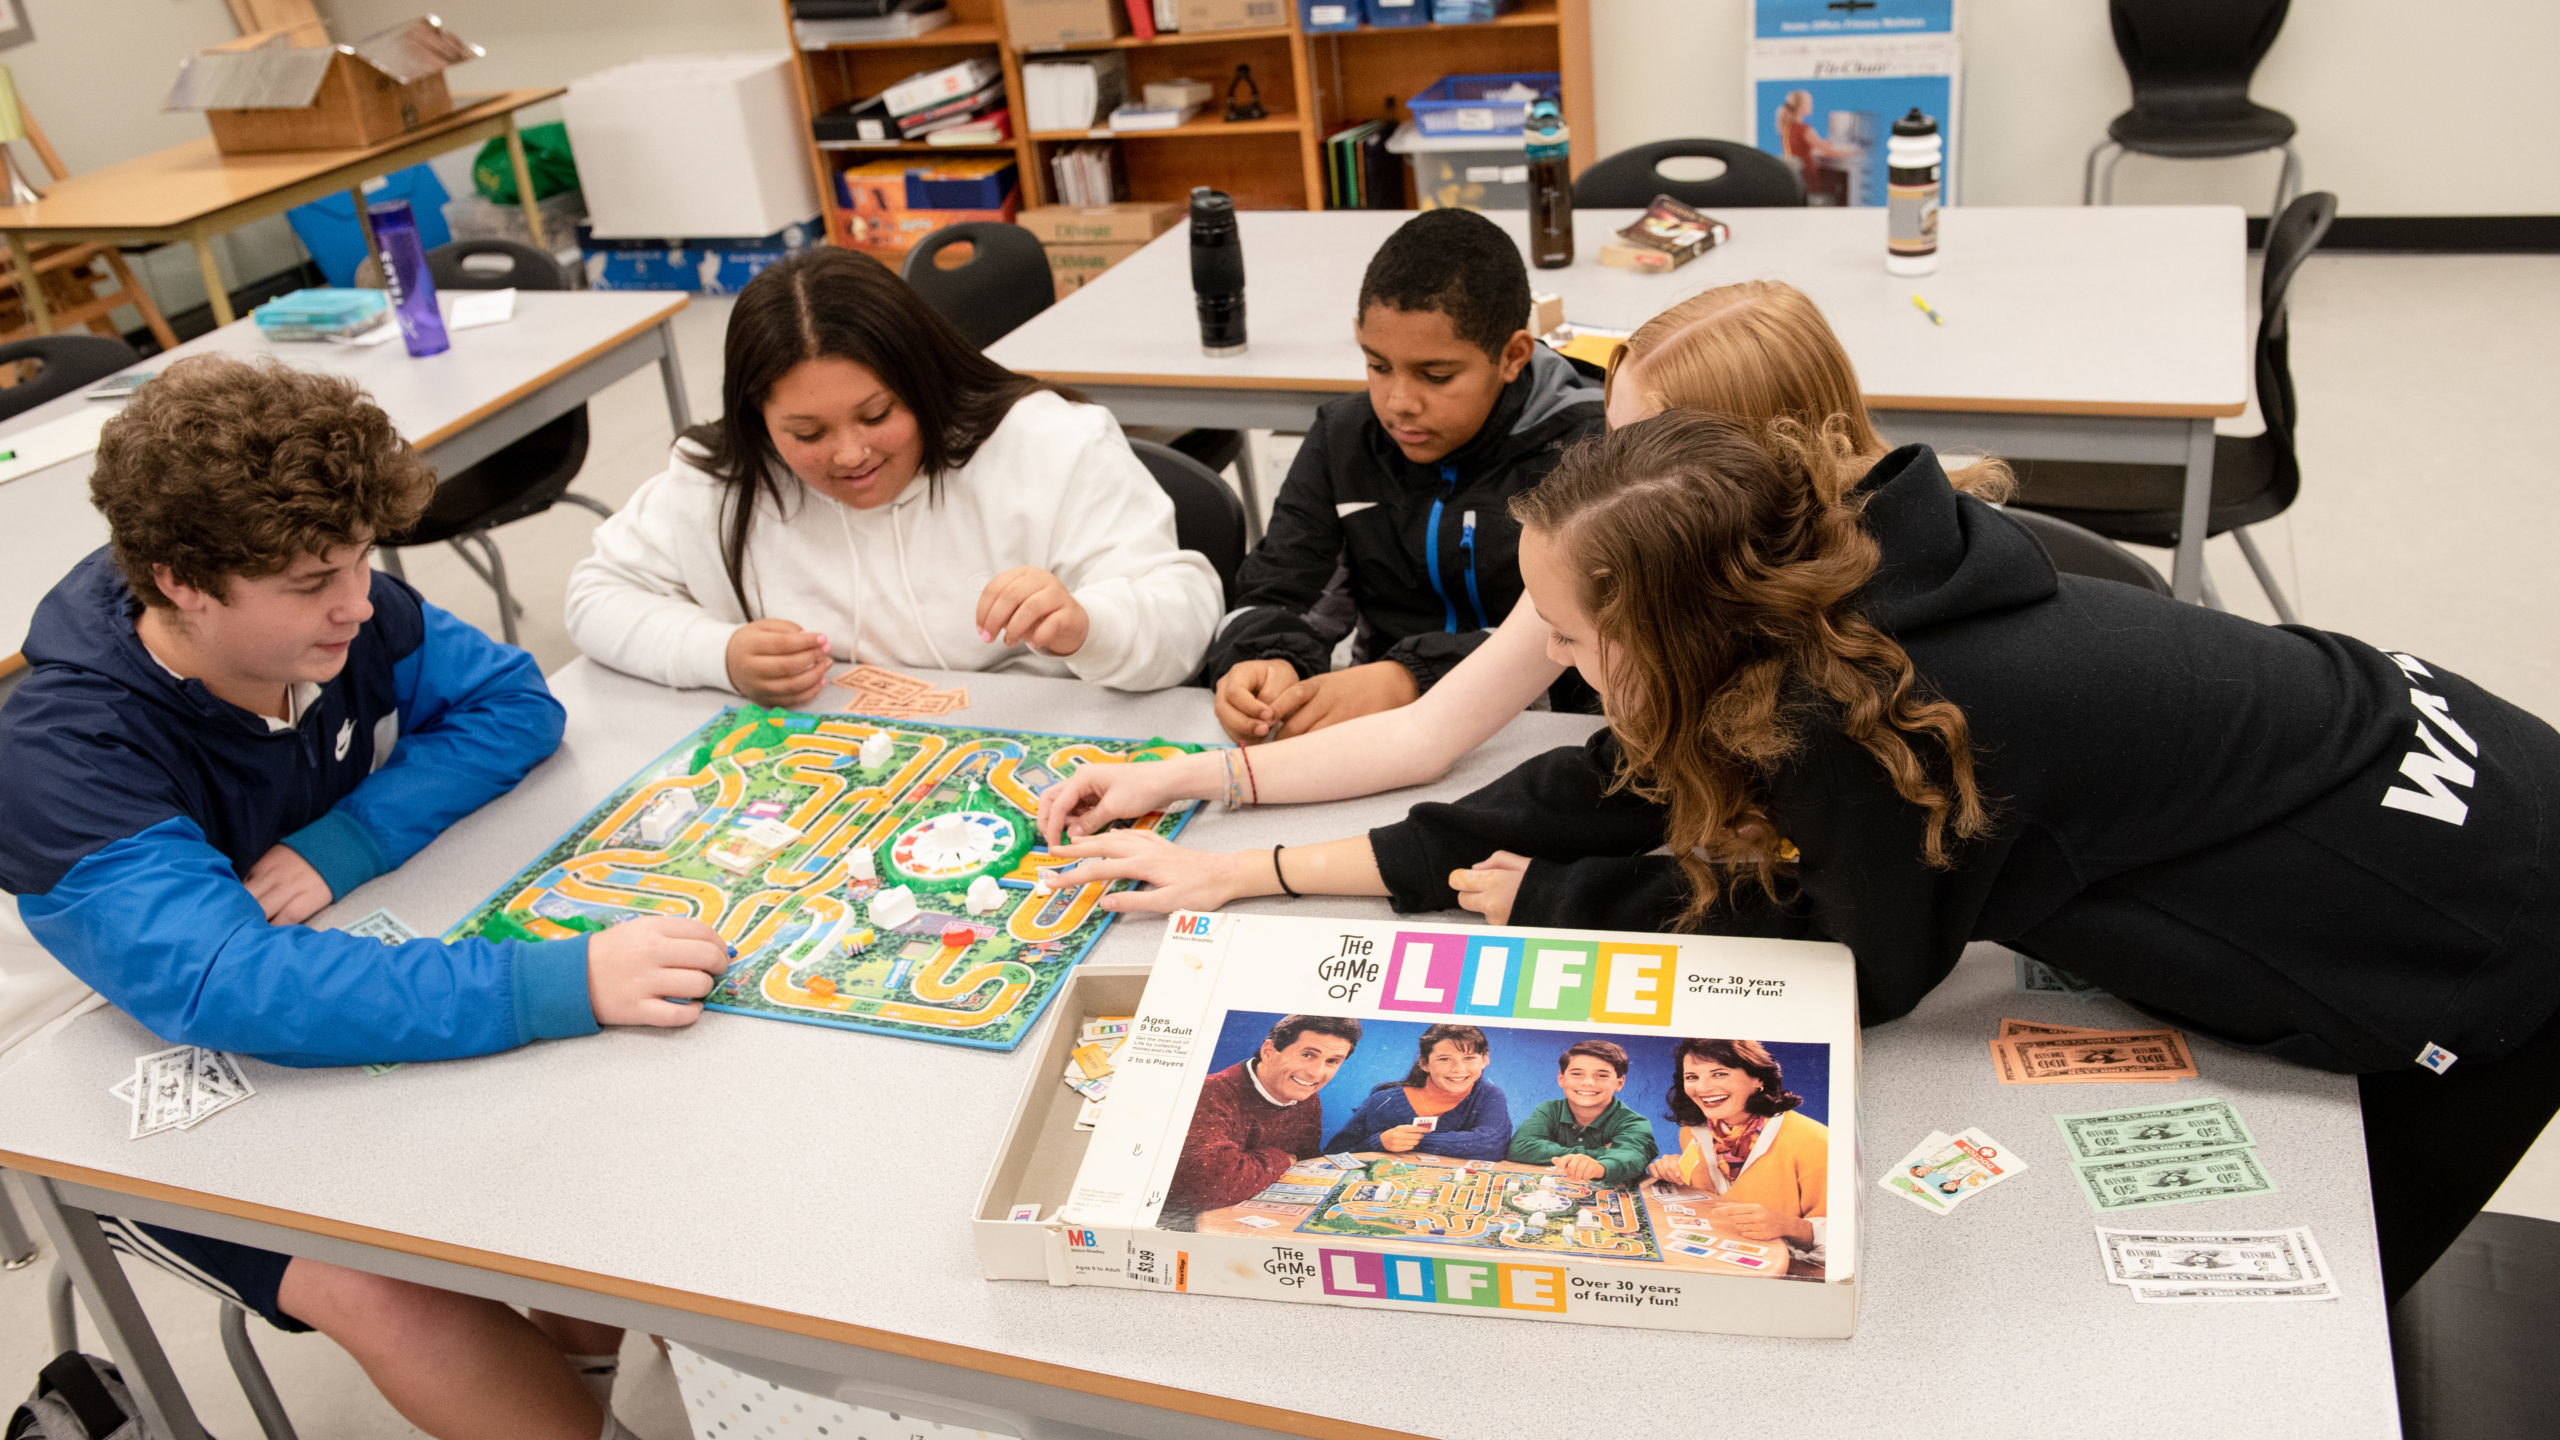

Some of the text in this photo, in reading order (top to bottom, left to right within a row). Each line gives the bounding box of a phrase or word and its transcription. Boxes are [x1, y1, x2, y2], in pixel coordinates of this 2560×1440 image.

[1175, 915, 1210, 935] MB
[1394, 942, 1662, 1015] LIFE
[1688, 974, 1786, 989] Over 30 years
[1688, 984, 1783, 998] of family fun!
[1142, 1015, 1170, 1025] Ages
[1150, 1025, 1160, 1033] to
[1163, 1026, 1192, 1035] Adult
[1153, 1059, 1184, 1068] Players
[2197, 1126, 2222, 1137] 50
[2095, 1135, 2119, 1146] 50
[1962, 1145, 1995, 1170] DOCTOR
[2216, 1172, 2242, 1184] 50
[2113, 1184, 2138, 1196] 50
[1068, 1229, 1096, 1247] MB
[1137, 1250, 1155, 1274] $3.99
[1330, 1255, 1556, 1307] LIFE
[1571, 1277, 1681, 1296] Over 30 years
[1574, 1289, 1680, 1308] of family fun!
